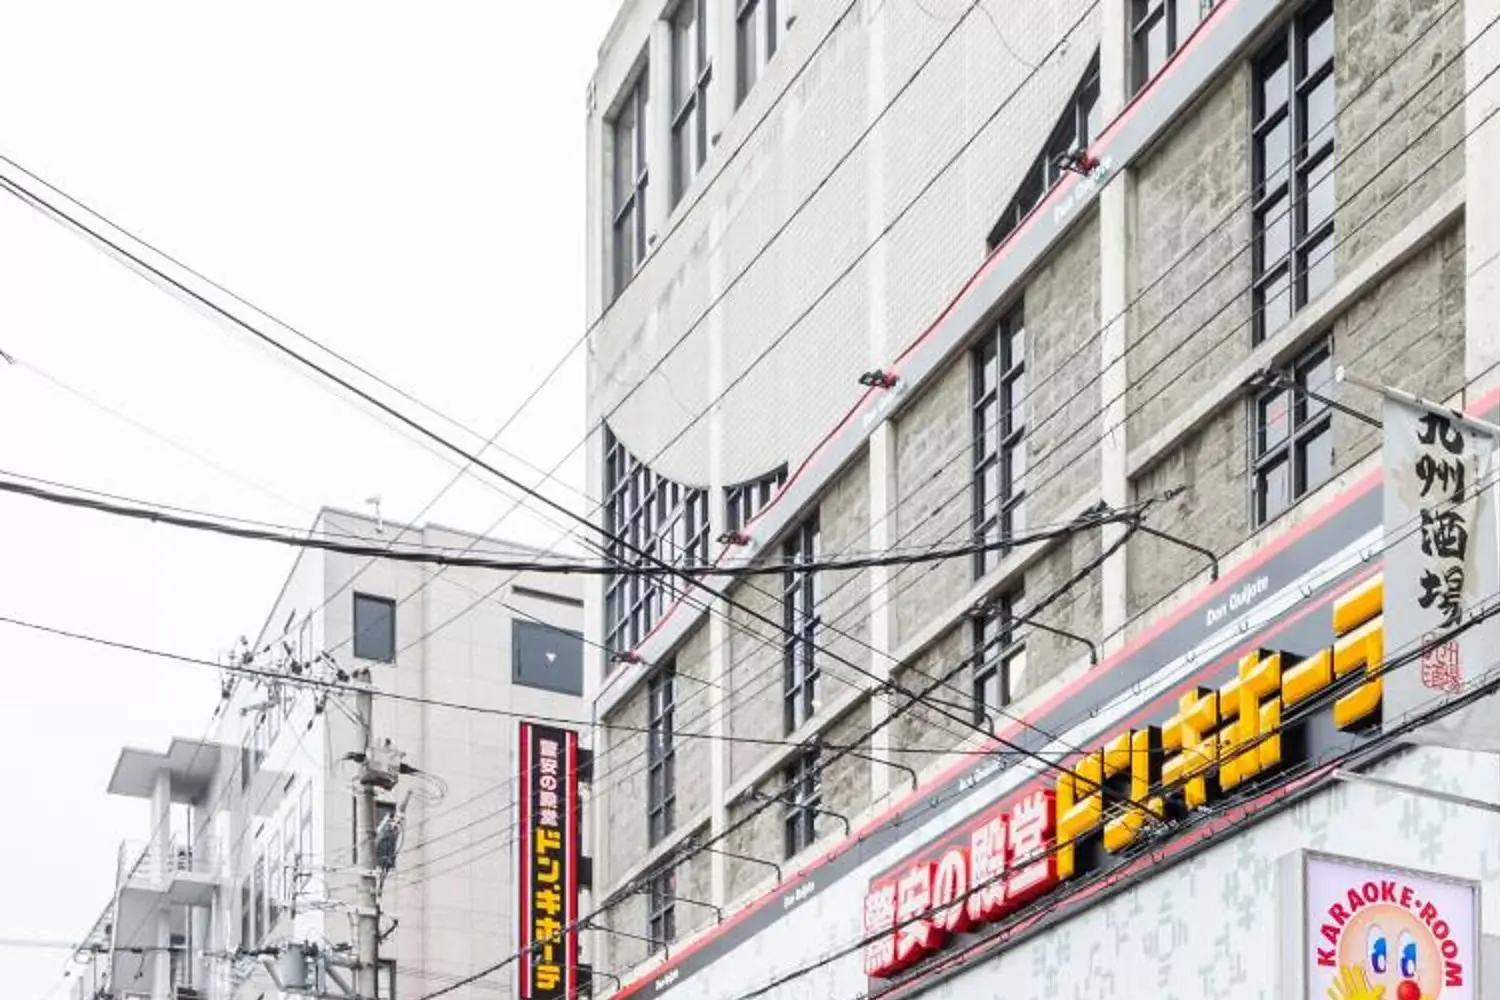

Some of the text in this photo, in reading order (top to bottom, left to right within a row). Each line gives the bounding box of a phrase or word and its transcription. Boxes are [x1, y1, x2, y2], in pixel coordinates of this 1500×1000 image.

[1415, 411, 1468, 630] 九州酒場
[864, 790, 1055, 976] 驚安の殿堂
